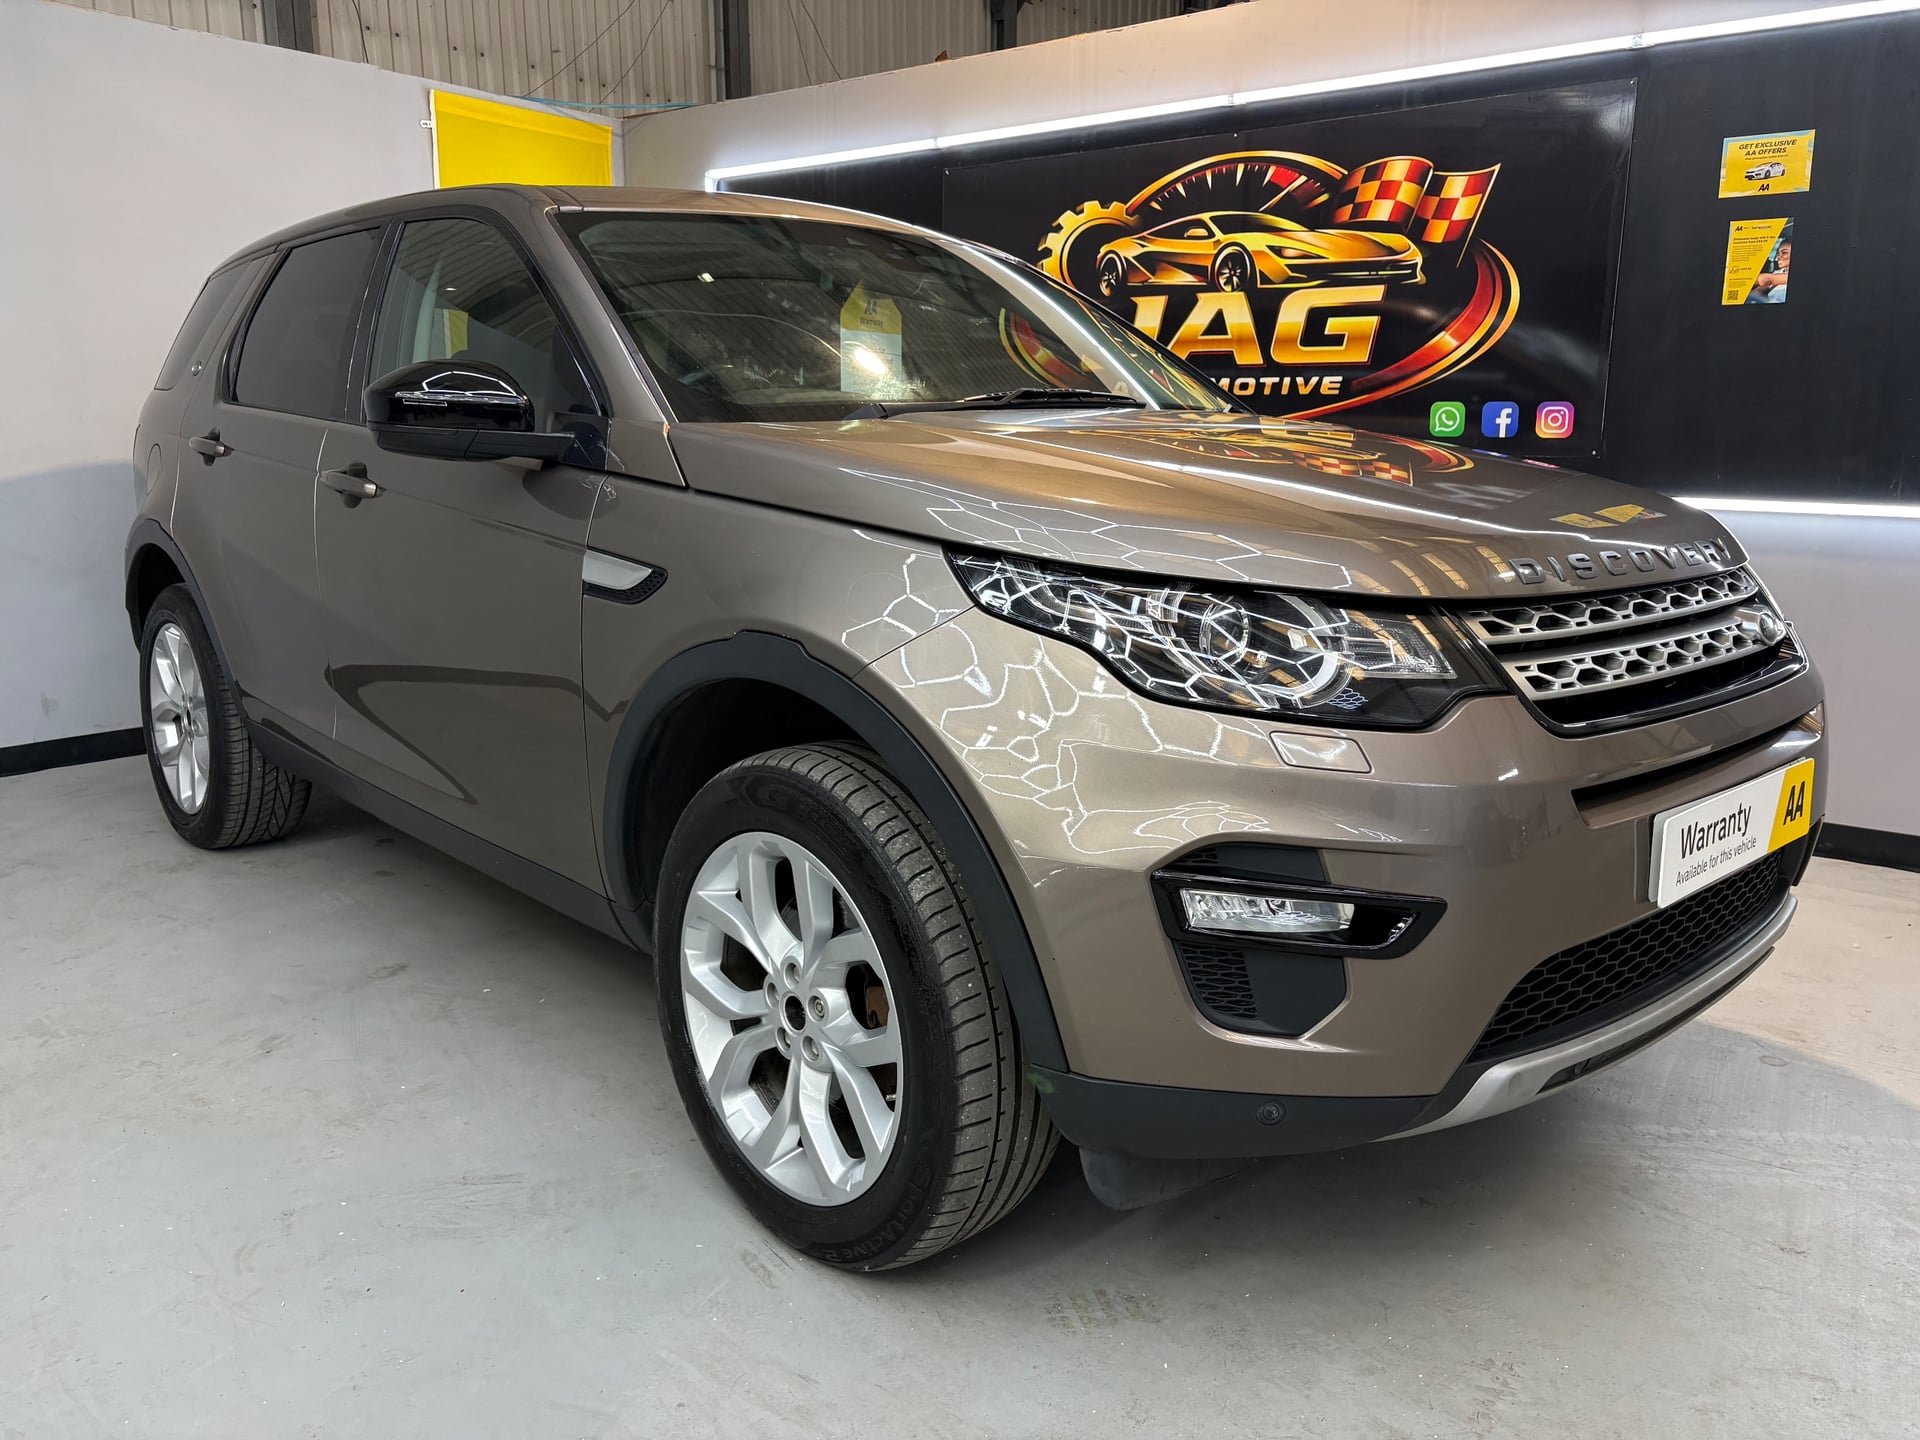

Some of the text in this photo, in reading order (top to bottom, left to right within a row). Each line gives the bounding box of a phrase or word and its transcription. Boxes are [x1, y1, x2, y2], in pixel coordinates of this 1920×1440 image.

[1755, 139, 1798, 149] EXCLUSIVE
[1758, 147, 1787, 155] OFFERS
[1758, 183, 1770, 192] AA
[1508, 538, 1731, 584] DISCOVERY
[1783, 781, 1806, 826] AA
[1681, 803, 1751, 859] Warranty
[1676, 836, 1756, 886] Available for this vehicle
